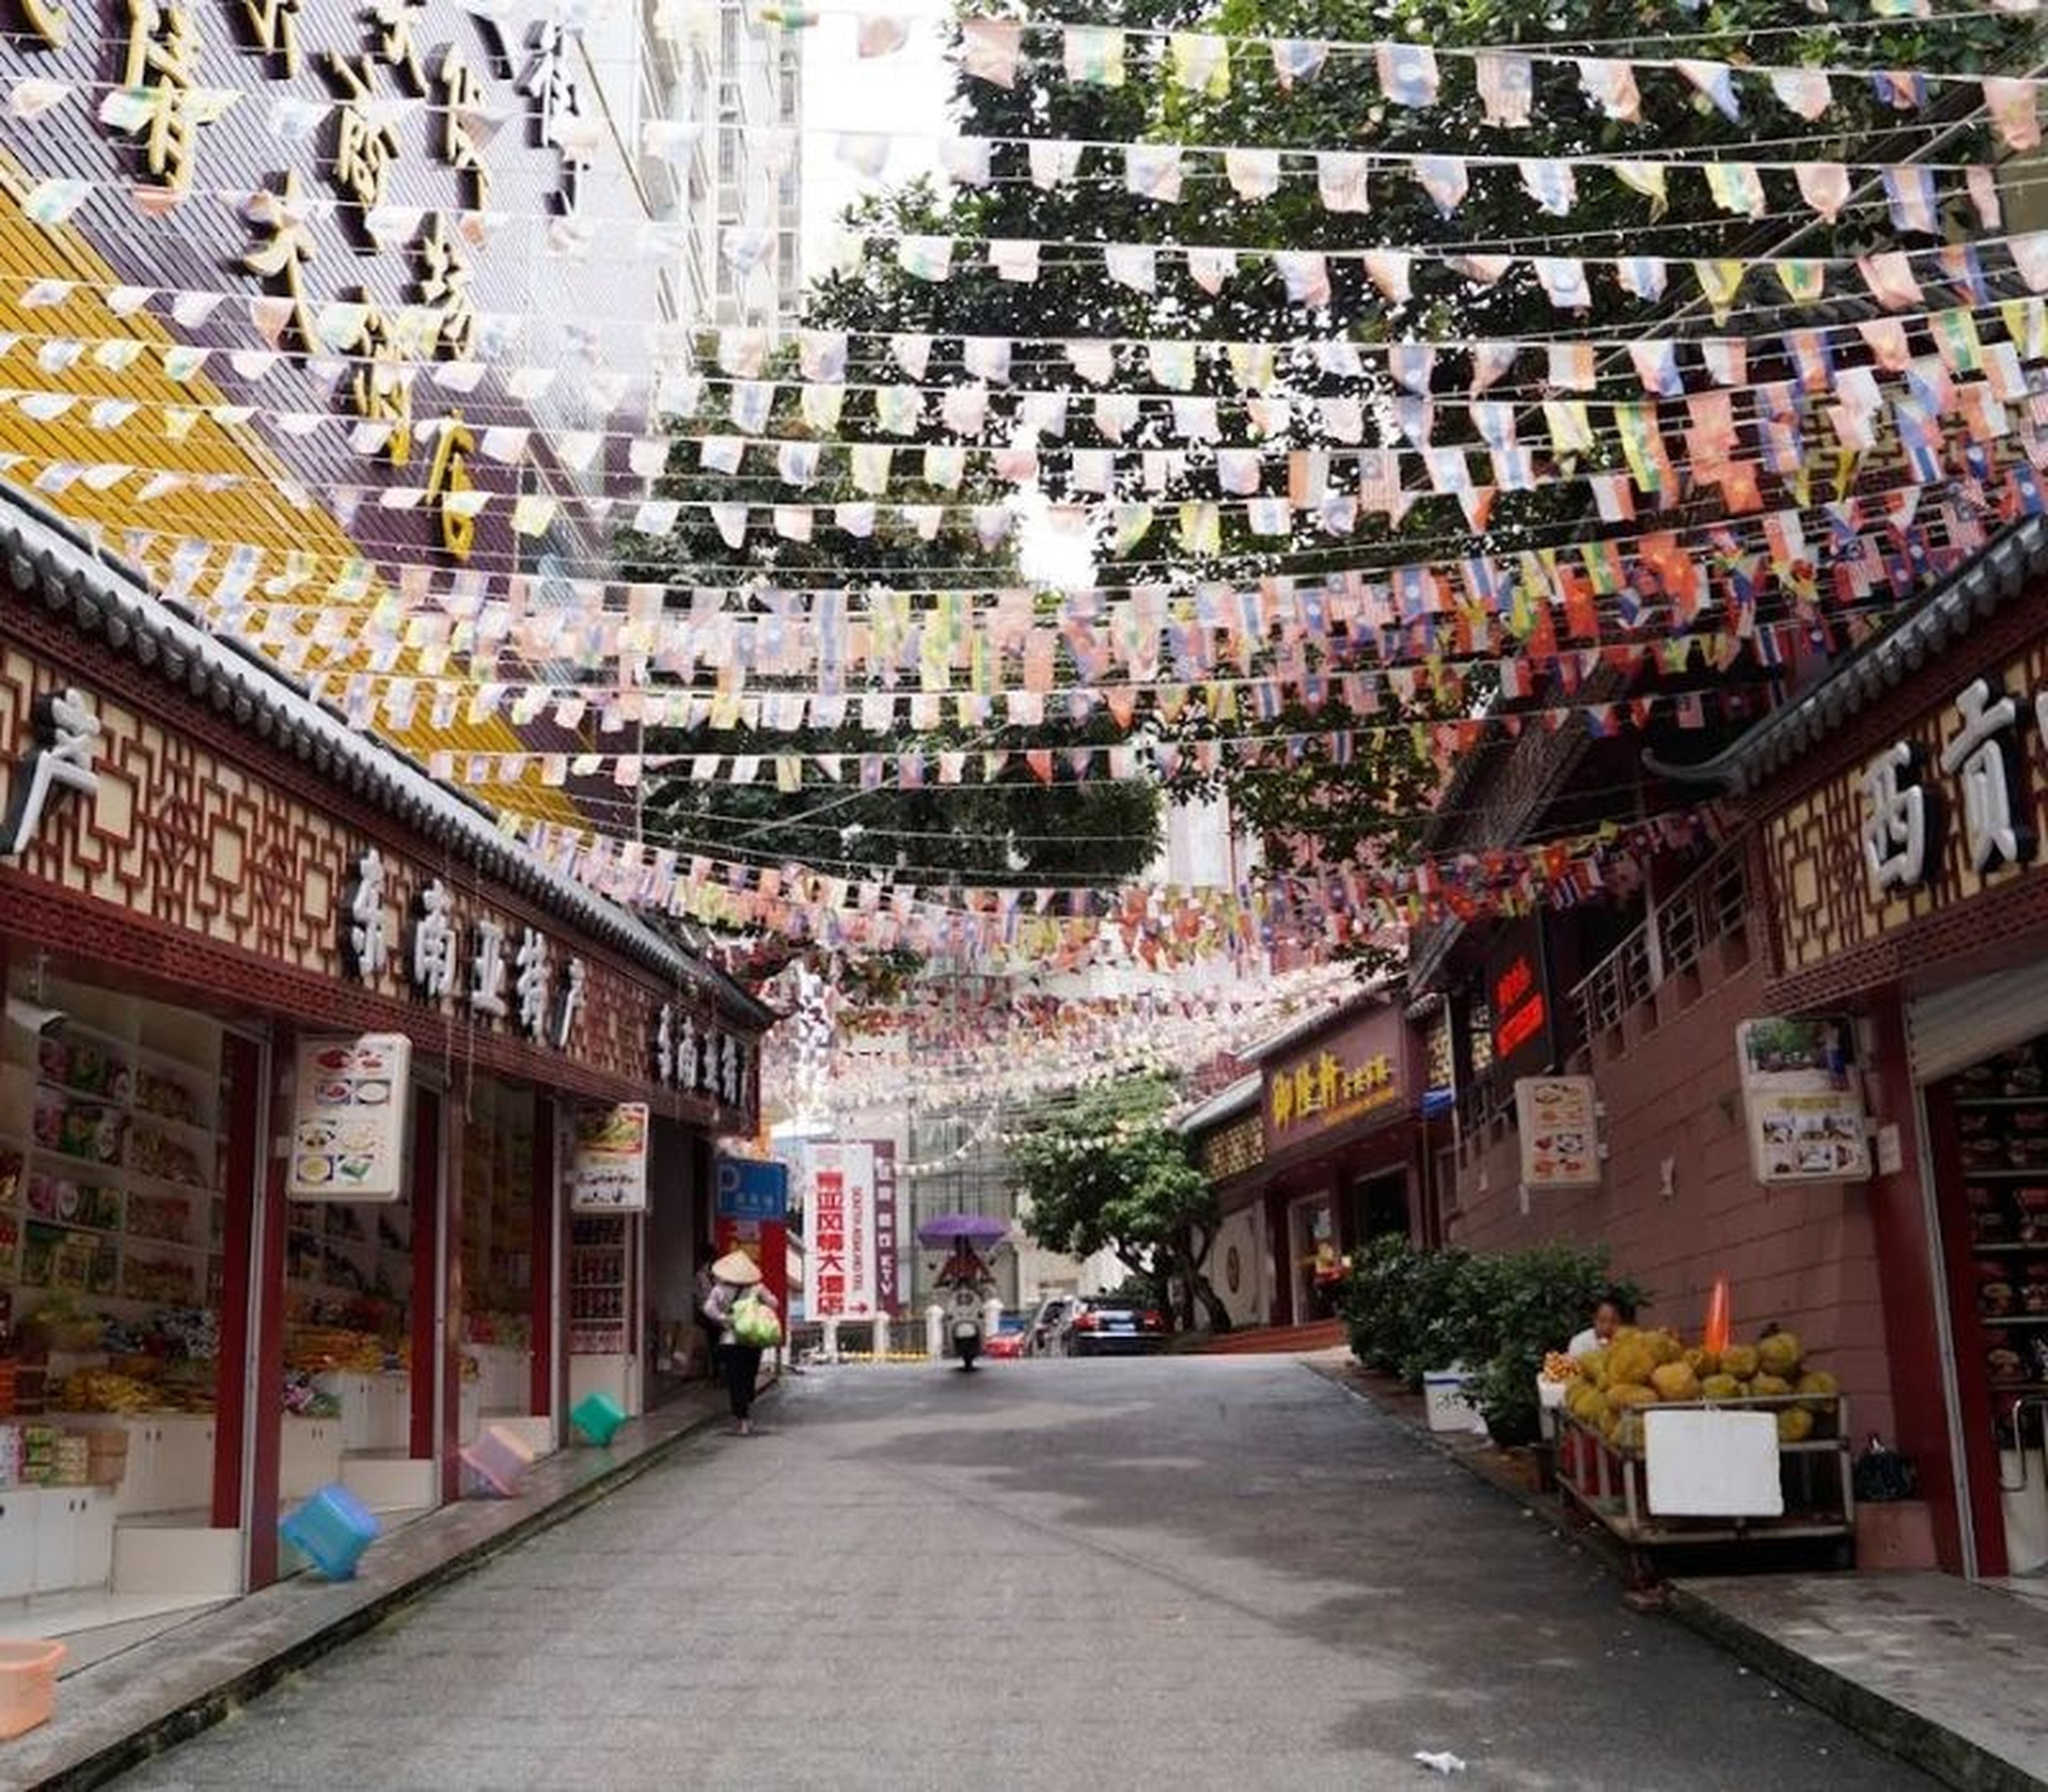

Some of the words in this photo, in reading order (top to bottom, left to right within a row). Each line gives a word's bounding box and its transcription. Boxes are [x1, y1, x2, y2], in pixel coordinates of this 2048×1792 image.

[13, 687, 101, 854] 产
[1860, 677, 2048, 889] 西贡
[351, 847, 586, 1047] 东南亚特产
[717, 1164, 740, 1209] P
[881, 1254, 893, 1295] KTV
